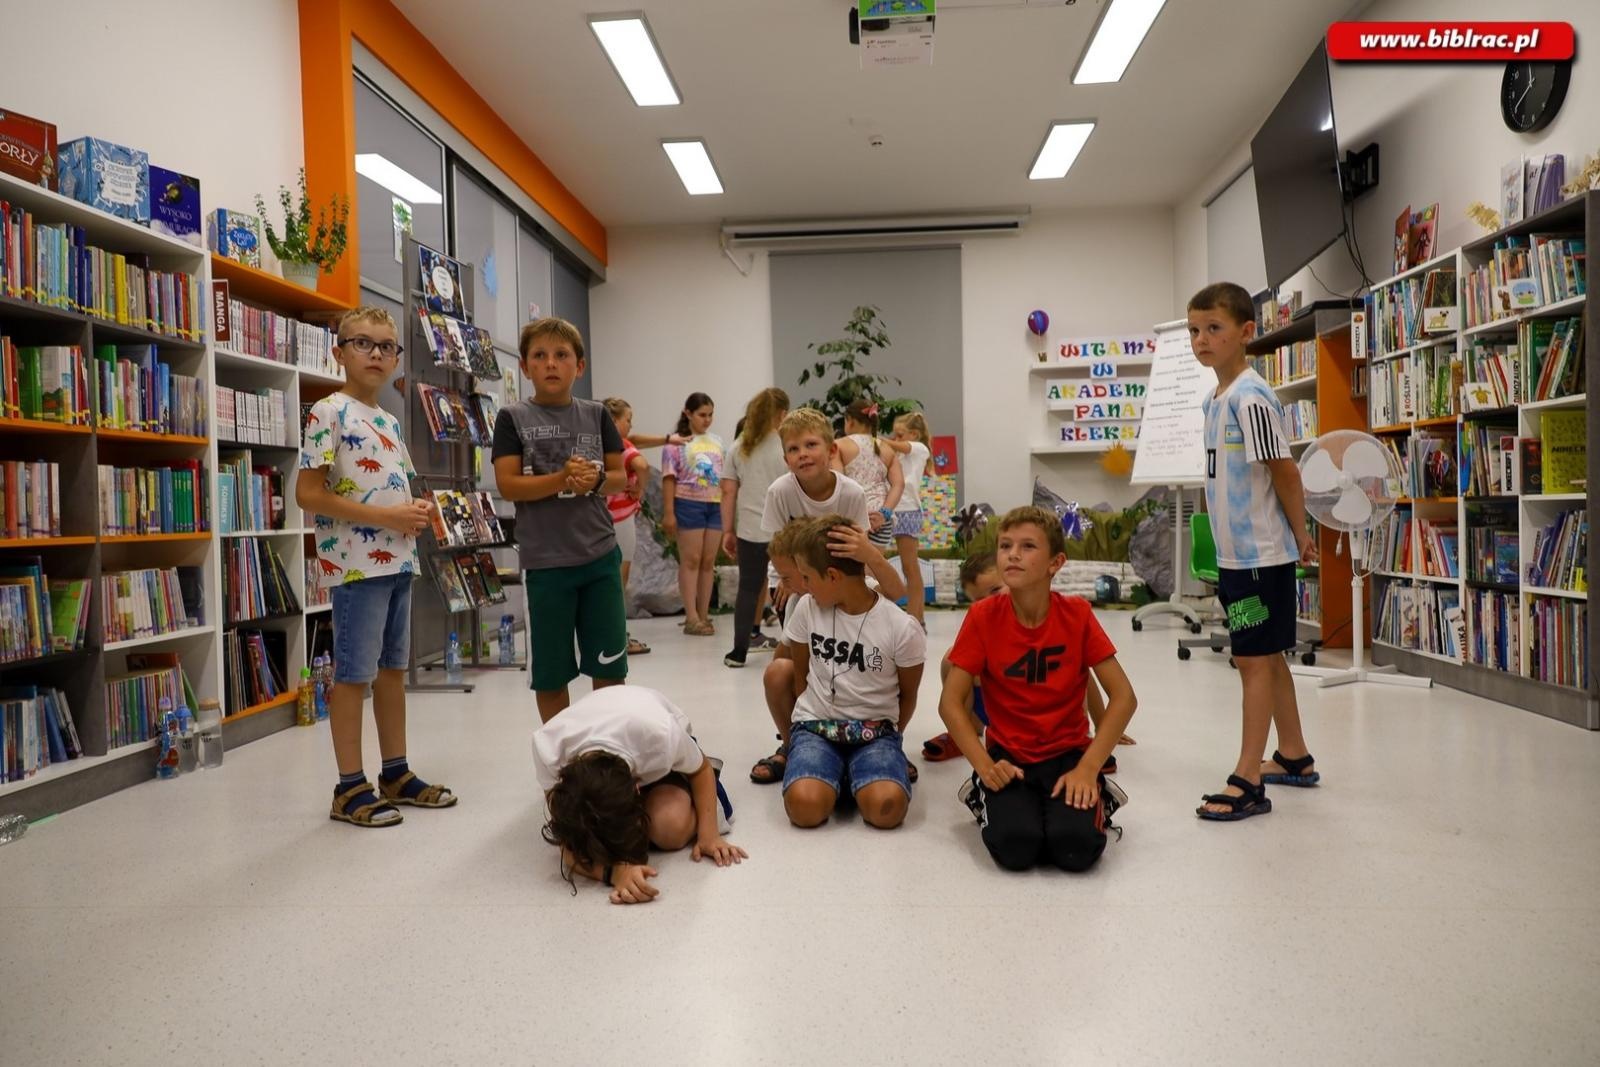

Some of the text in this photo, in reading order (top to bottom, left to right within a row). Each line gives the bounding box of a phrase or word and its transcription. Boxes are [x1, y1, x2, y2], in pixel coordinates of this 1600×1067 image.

[159, 205, 193, 221] WYSOKO
[215, 291, 226, 332] MANGA
[1048, 383, 1148, 399] AKADEM
[1075, 402, 1136, 419] PANA
[811, 632, 866, 672] ESSA
[1004, 645, 1067, 685] 4F
